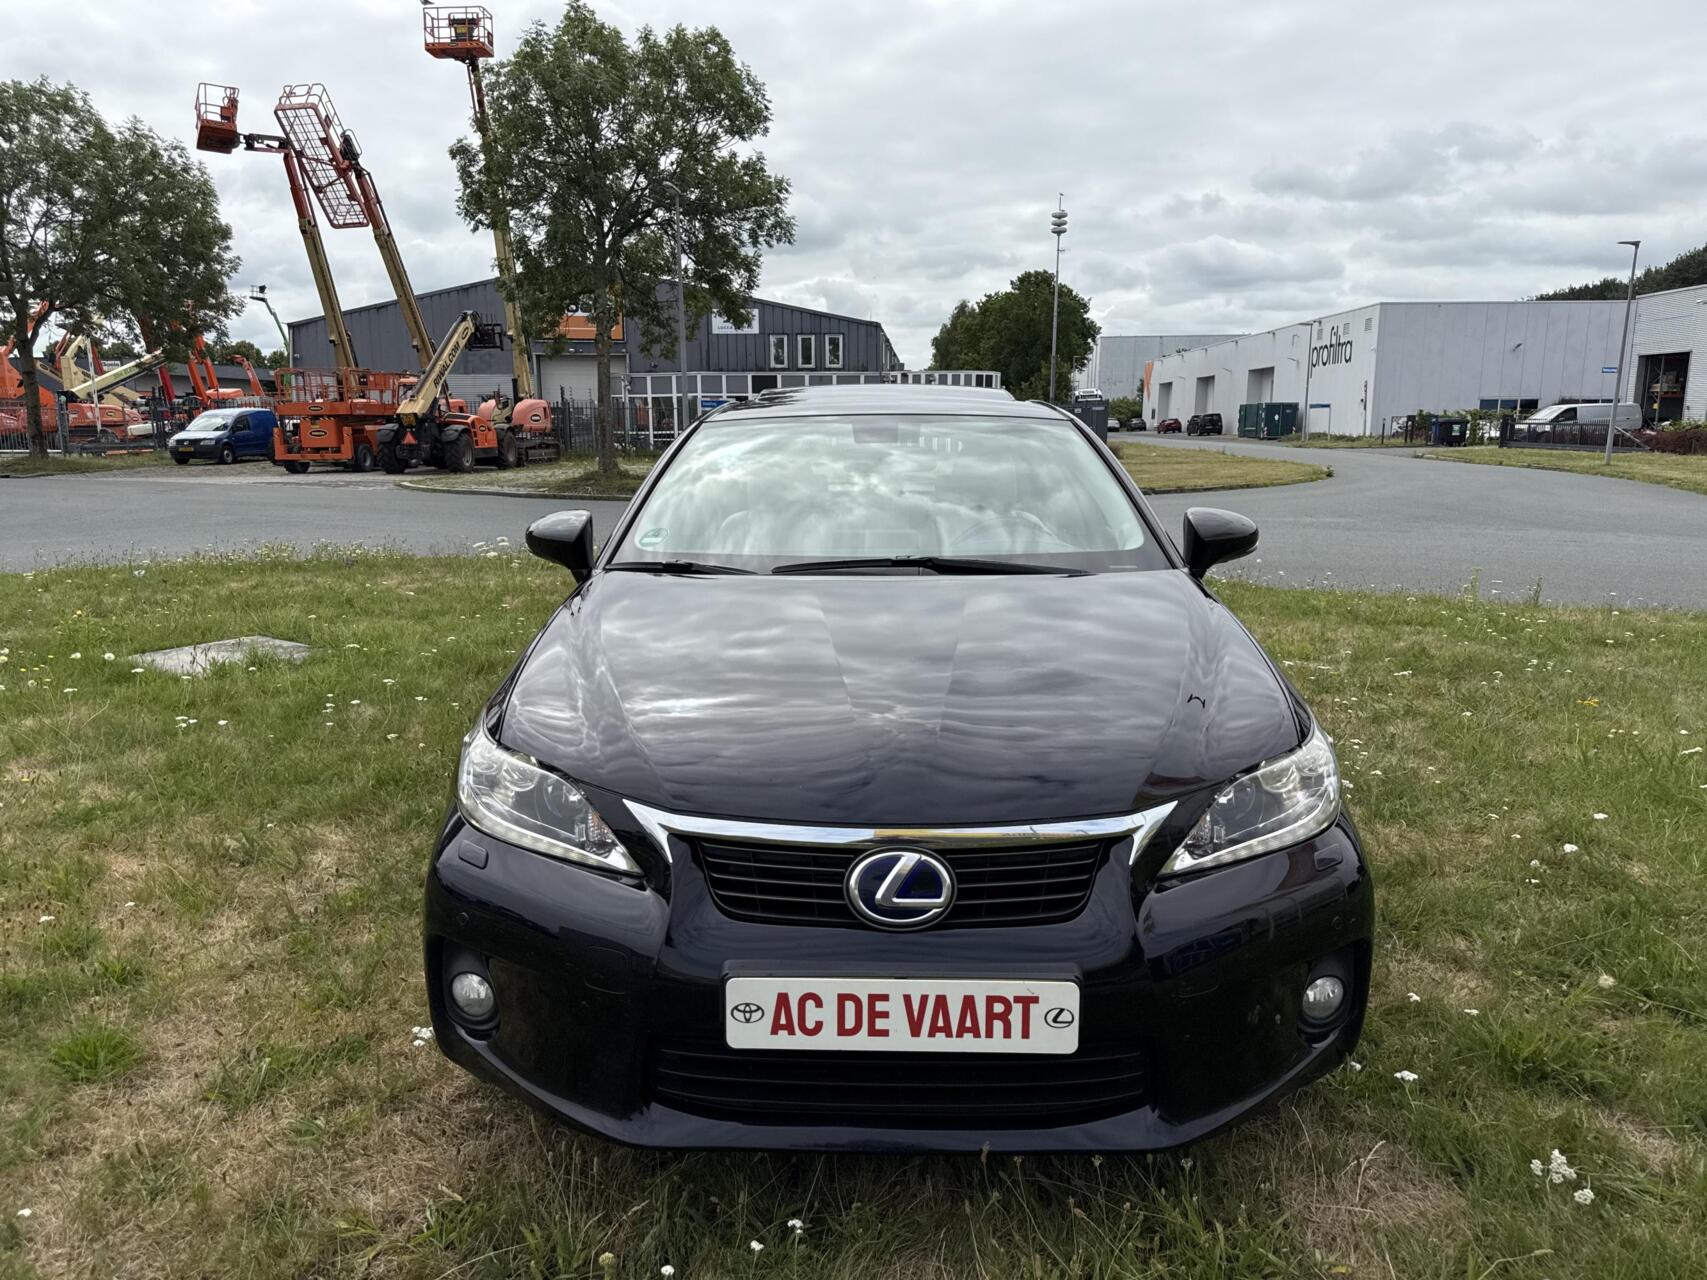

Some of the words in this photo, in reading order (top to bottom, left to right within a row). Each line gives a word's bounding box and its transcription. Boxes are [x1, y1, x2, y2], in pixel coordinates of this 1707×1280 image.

[1310, 325, 1352, 379] profiltra
[769, 992, 823, 1036] AC
[836, 993, 890, 1037] DE
[903, 993, 1039, 1039] VAART
